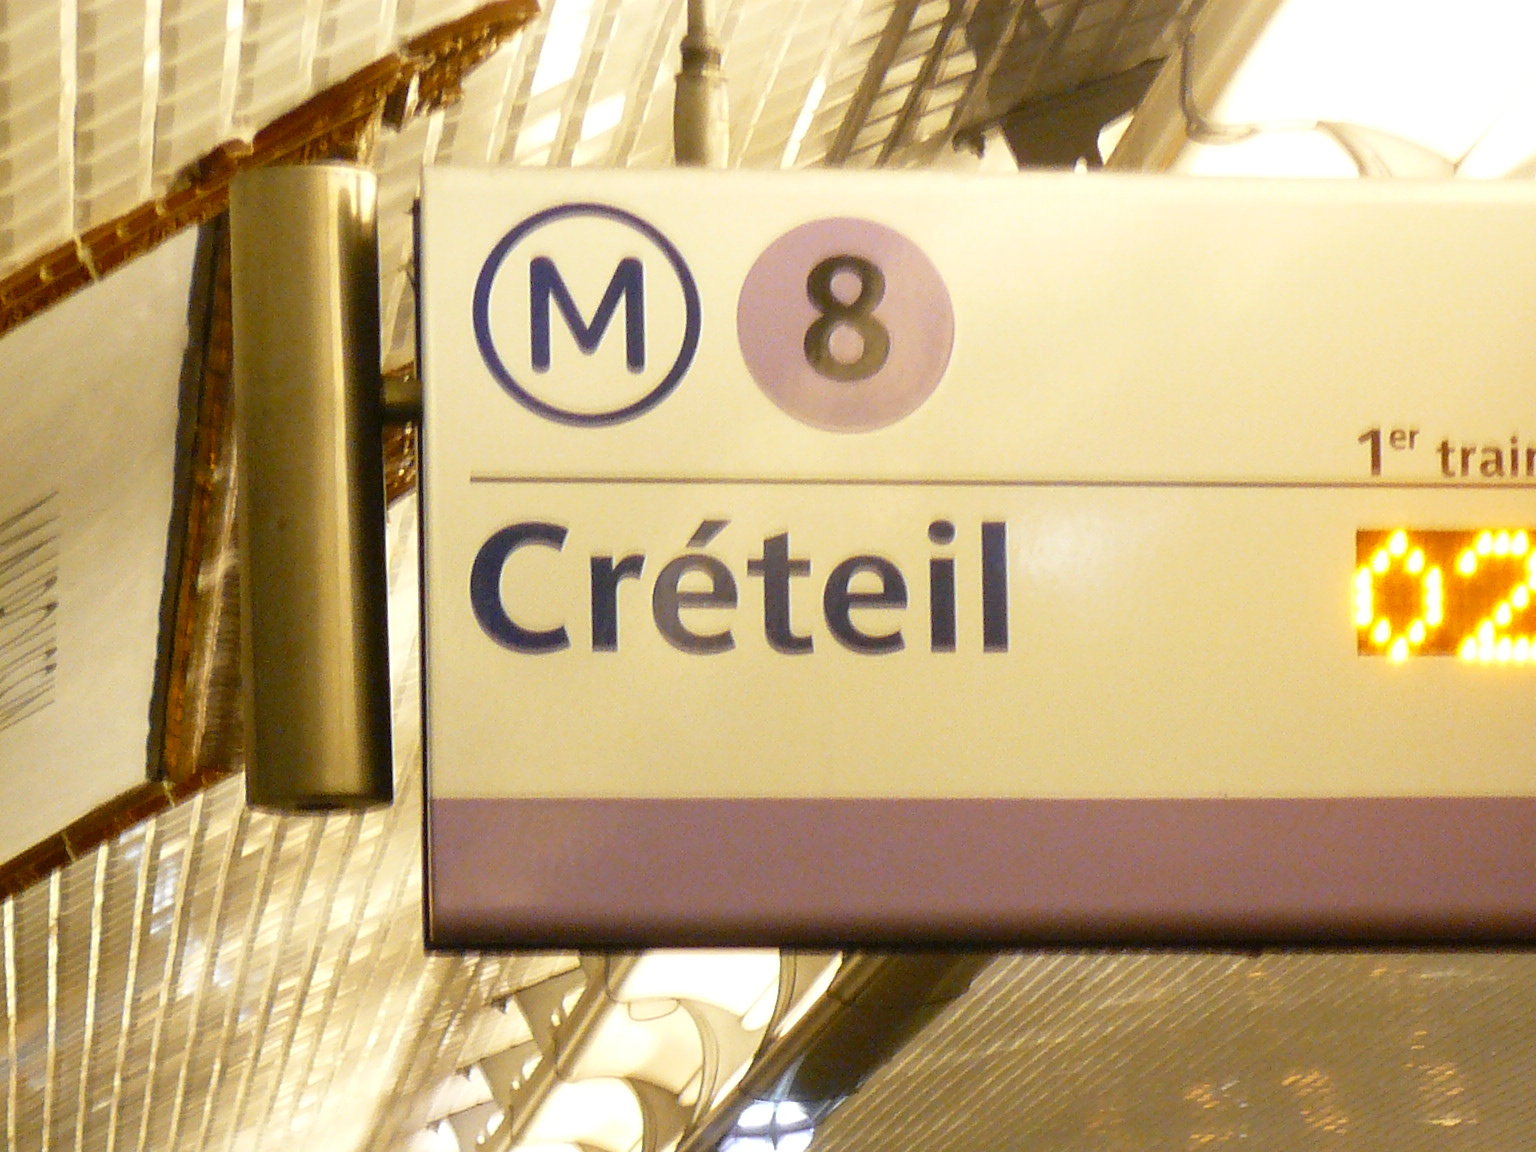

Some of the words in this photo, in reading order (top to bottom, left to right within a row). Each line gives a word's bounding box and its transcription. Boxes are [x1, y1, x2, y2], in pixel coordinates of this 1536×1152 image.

[529, 256, 646, 374] M
[803, 253, 891, 382] 8
[469, 519, 1009, 655] Créteil
